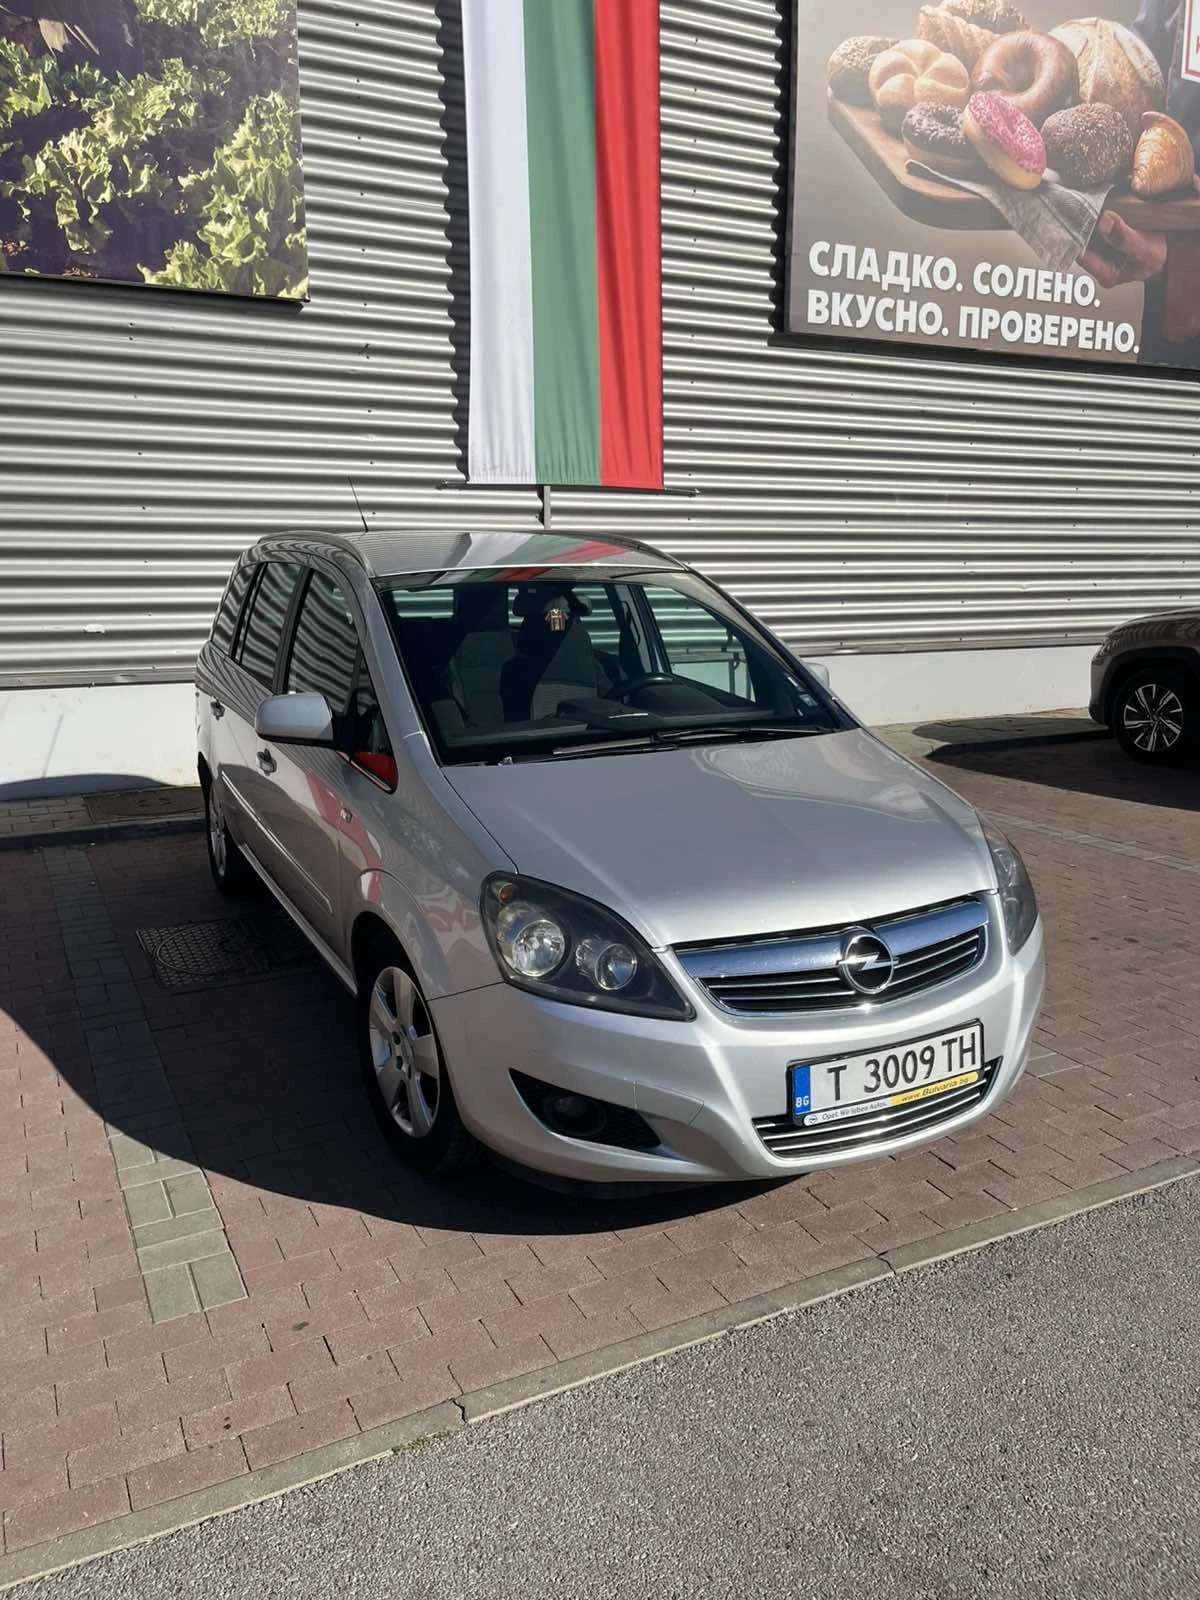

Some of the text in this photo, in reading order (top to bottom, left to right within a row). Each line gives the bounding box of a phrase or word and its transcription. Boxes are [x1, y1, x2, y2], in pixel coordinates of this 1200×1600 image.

[808, 240, 1101, 308] СЛАДКО. СОЛЕНО.
[807, 289, 1140, 354] ВКУСНО. ПРОВЕРЕНО.
[827, 1032, 976, 1101] T 3009 TH
[795, 1095, 809, 1108] BG
